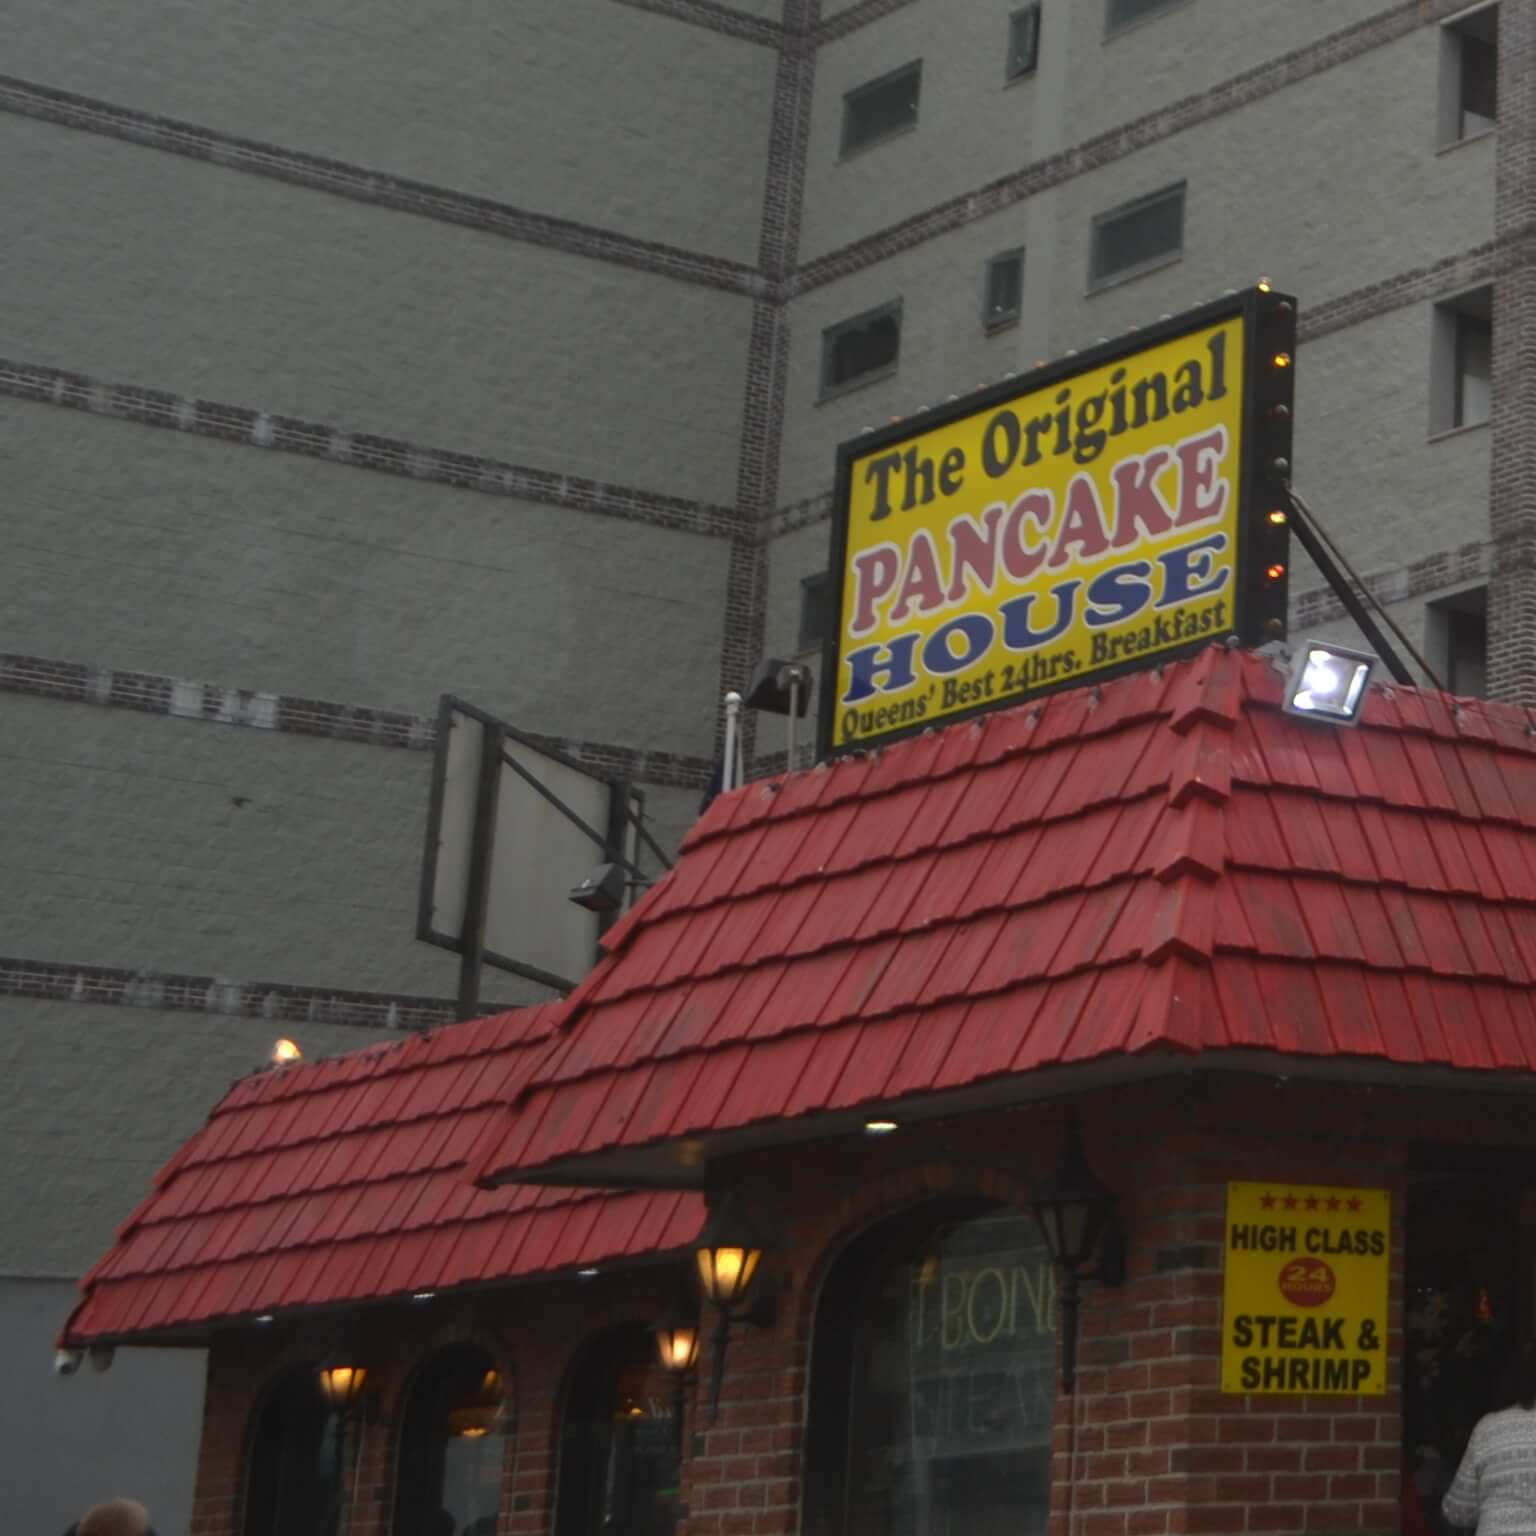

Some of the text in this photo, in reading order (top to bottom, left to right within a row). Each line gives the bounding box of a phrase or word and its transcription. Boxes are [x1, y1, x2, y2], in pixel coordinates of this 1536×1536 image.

[865, 330, 1227, 522] The Original
[850, 427, 1228, 636] PANCAKE
[842, 533, 1229, 704] HOUSE
[842, 600, 1226, 740] Queens' Best 24hrs. Breakfast
[1231, 1223, 1385, 1256] HIGH CLASS
[1287, 1265, 1330, 1284] 24
[1232, 1315, 1380, 1351] STEAK &
[1240, 1356, 1372, 1391] SHRIMP
